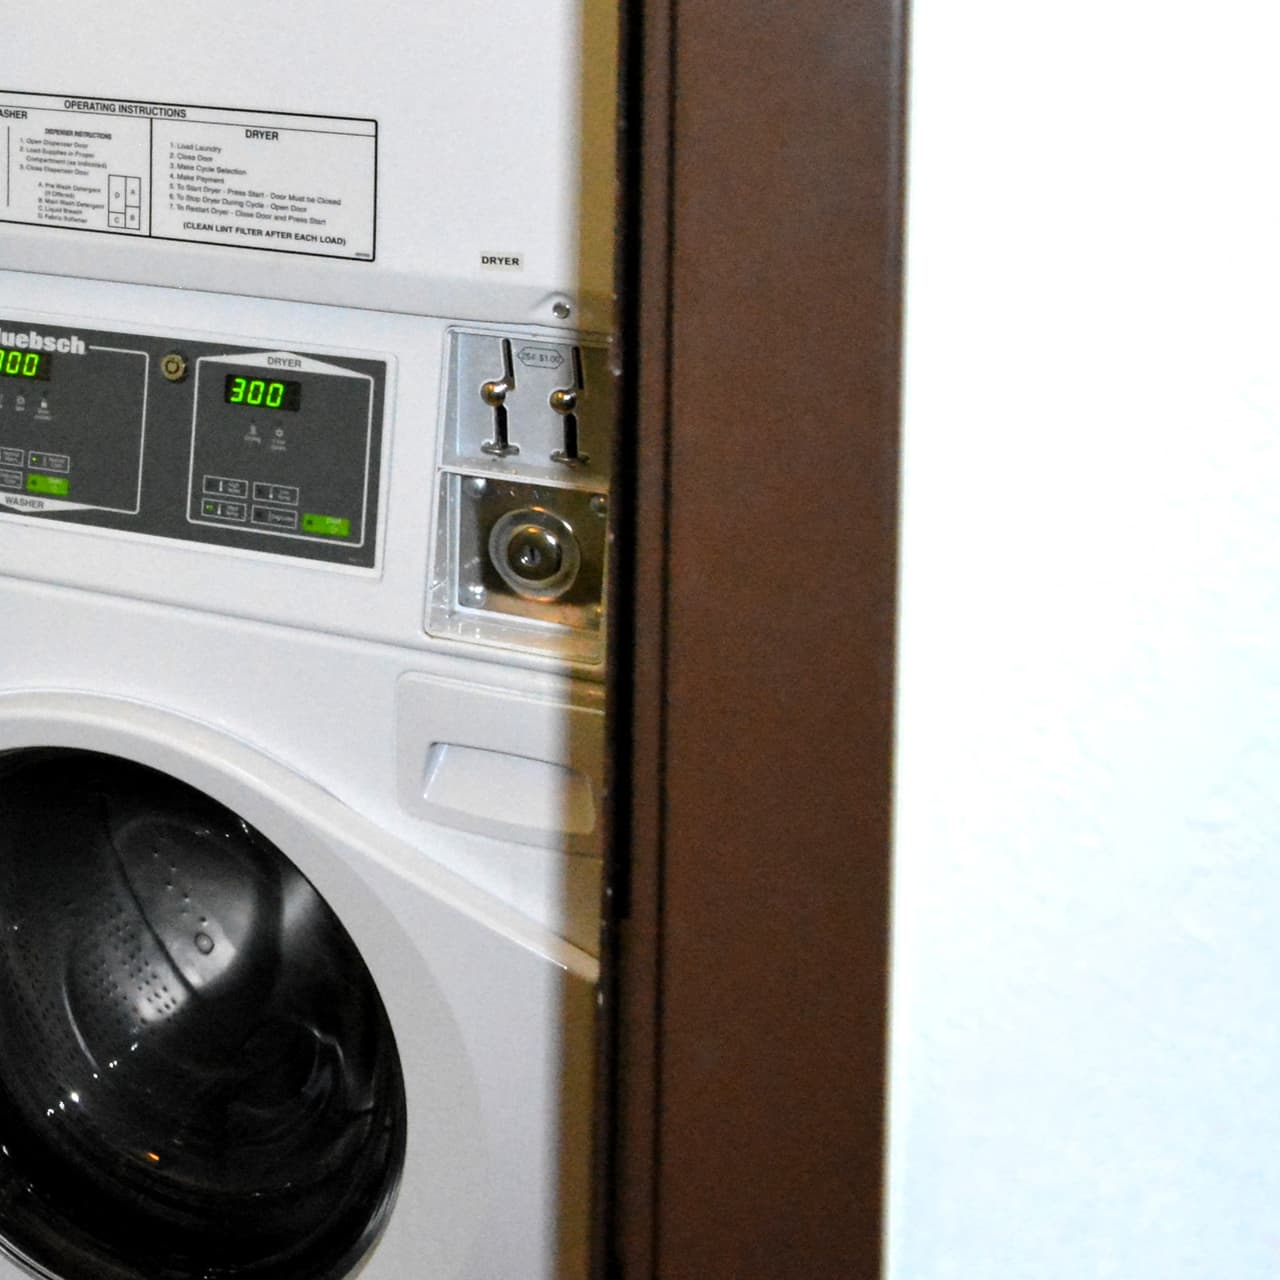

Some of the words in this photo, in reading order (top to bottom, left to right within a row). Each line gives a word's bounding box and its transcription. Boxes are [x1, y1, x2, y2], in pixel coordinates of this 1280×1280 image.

[64, 100, 115, 112] OPERATING
[118, 101, 186, 118] INSTRUCTIONS
[245, 129, 278, 141] DRYER
[183, 221, 213, 231] (CLEAN
[216, 224, 232, 233] LINT
[235, 227, 262, 236] FILTER
[265, 229, 292, 239] AFTER
[295, 233, 317, 242] EACH
[320, 235, 346, 246] LOAD)
[482, 256, 519, 265] DRYER
[268, 357, 302, 368] DRYER
[230, 378, 284, 407] 300
[5, 496, 44, 509] WASHER
